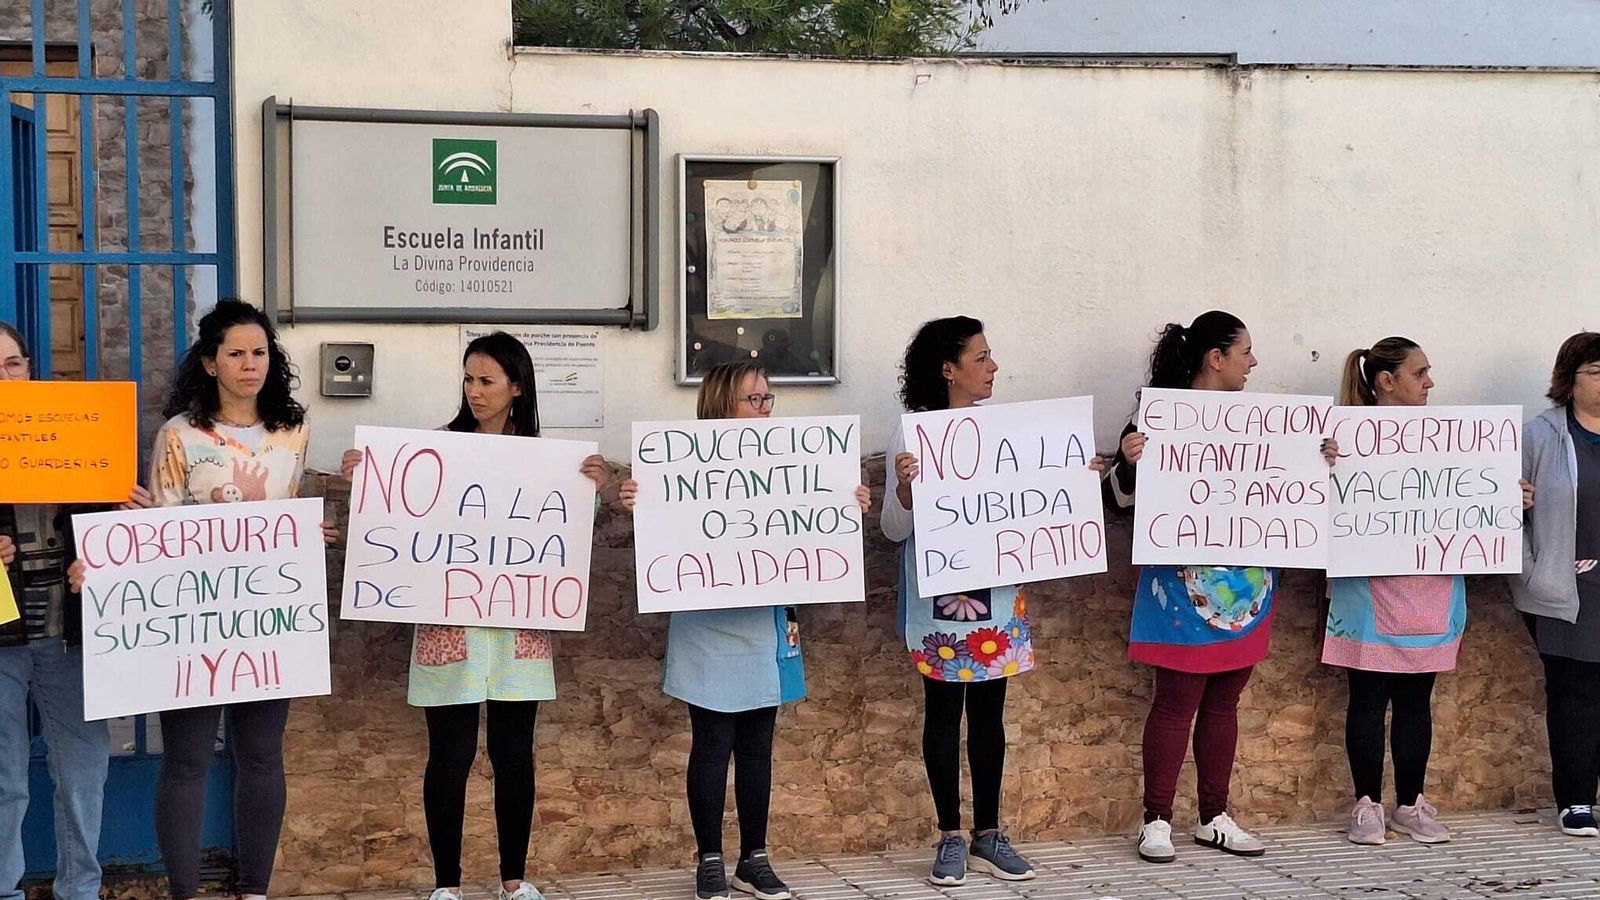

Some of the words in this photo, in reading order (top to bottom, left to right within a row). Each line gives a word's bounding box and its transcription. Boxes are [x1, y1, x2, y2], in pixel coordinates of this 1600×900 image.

[384, 225, 464, 249] Escuela
[474, 227, 544, 250] Infantil
[393, 255, 408, 271] La
[414, 255, 453, 271] Divina
[459, 256, 534, 272] Providencia
[415, 279, 455, 295] Código:
[461, 280, 513, 293] 14010521
[38, 412, 100, 423] ESCUELAS
[1144, 399, 1334, 437] EDUCACION
[638, 423, 854, 464] EDUCACION
[916, 417, 981, 483] NO
[995, 438, 1018, 474] A
[1039, 434, 1086, 469] LA
[1332, 417, 1518, 458] COBERTURA
[20, 456, 109, 469] GUARDERIAS
[1159, 442, 1287, 473] INFANTIL
[358, 442, 443, 518] NO
[458, 483, 486, 519] A
[508, 487, 567, 523] LA
[663, 464, 833, 502] INFANTIL
[1190, 479, 1236, 505] 0-3
[1246, 475, 1325, 507] AÑOS
[1330, 467, 1498, 504] VACANTES
[702, 509, 758, 539] 0-3
[765, 504, 860, 536] AÑOS
[929, 488, 1073, 532] SUBIDA
[1333, 504, 1523, 538] SUSTITUCIONES
[82, 514, 298, 569] COBERTURA
[357, 526, 566, 568] SUBIDA
[924, 549, 971, 578] DE
[995, 520, 1101, 576] RATIO
[1149, 513, 1318, 549] CALIDAD
[646, 547, 849, 593] CALIDAD
[87, 562, 302, 619] VACANTES
[353, 580, 418, 609] DE
[444, 568, 583, 619] RATIO
[93, 603, 325, 656] SUSTITUCIONES
